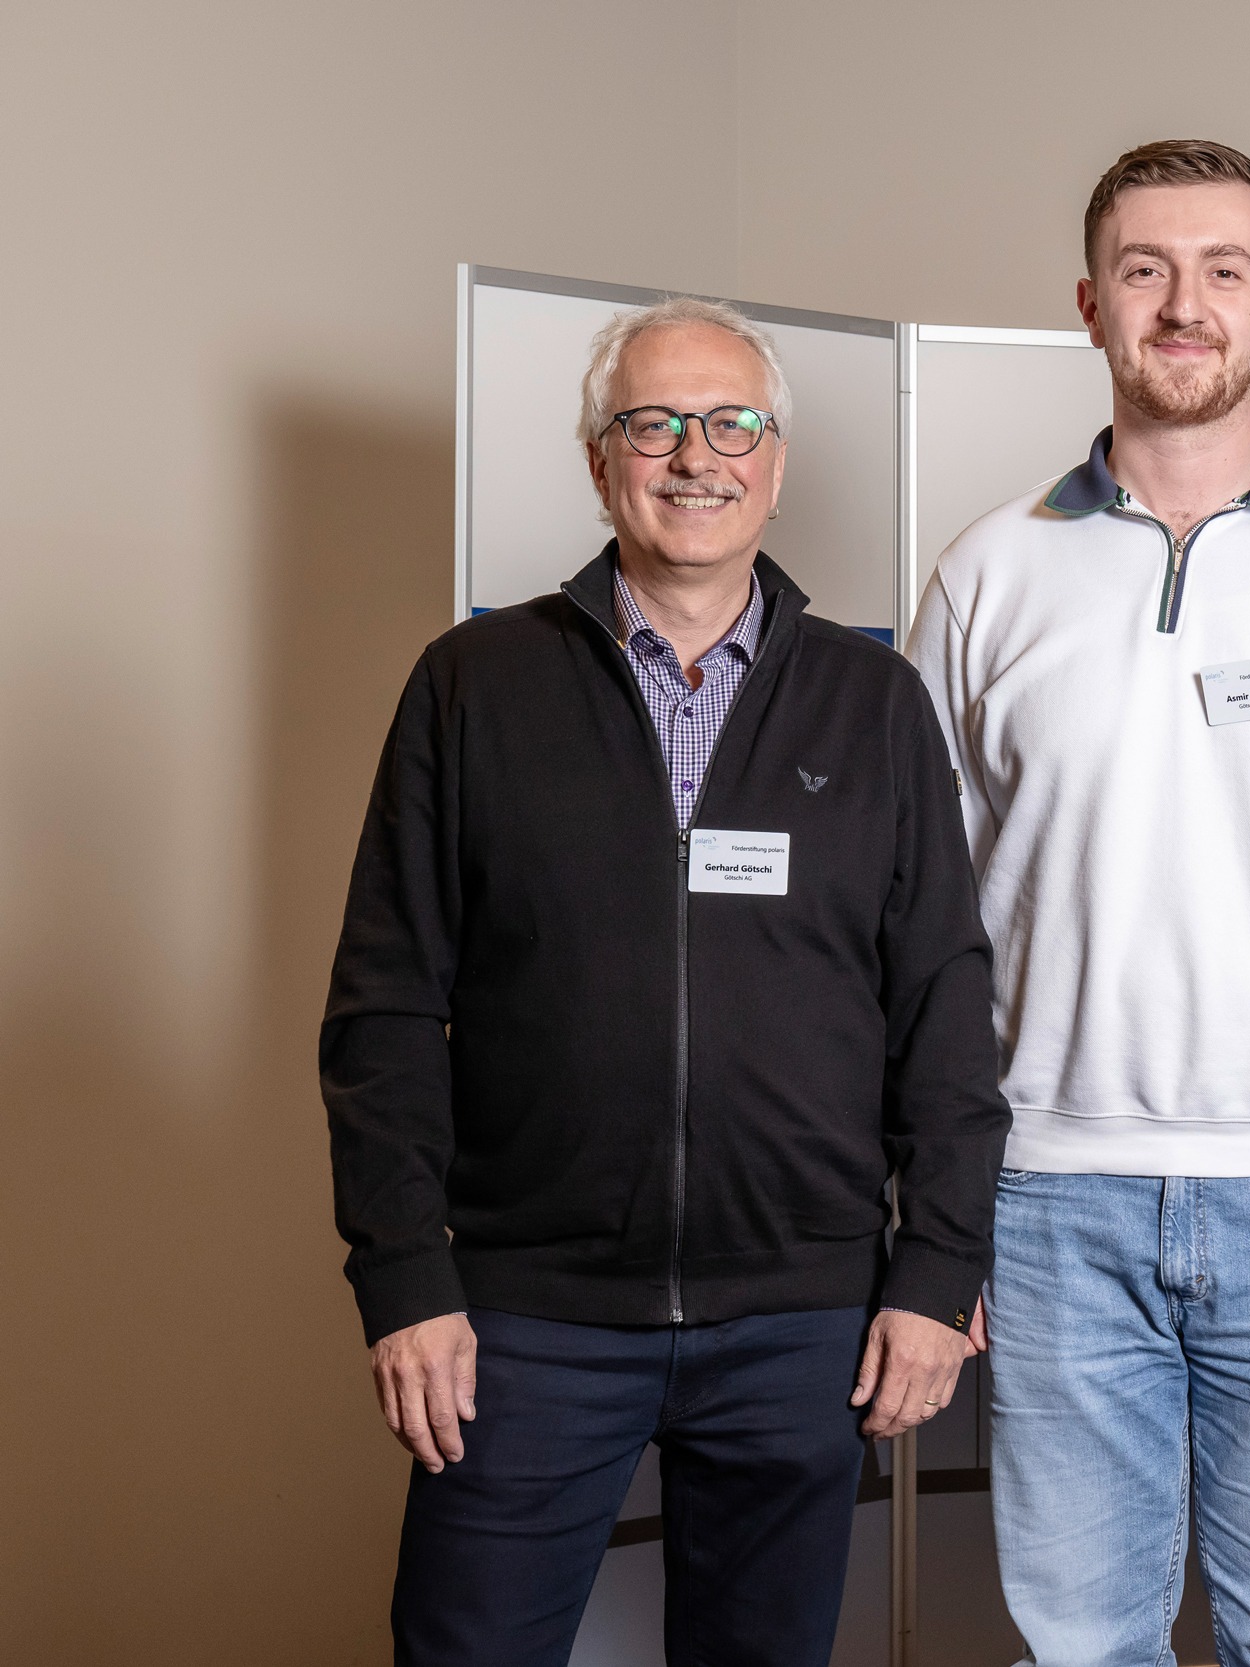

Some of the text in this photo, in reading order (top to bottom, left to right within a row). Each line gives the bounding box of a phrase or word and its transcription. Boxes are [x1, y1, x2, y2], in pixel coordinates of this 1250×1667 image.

[1226, 692, 1249, 703] Asmir
[695, 837, 712, 845] polaris
[731, 845, 767, 853] Förderstiftung
[705, 863, 772, 873] Gerhard Götschi
